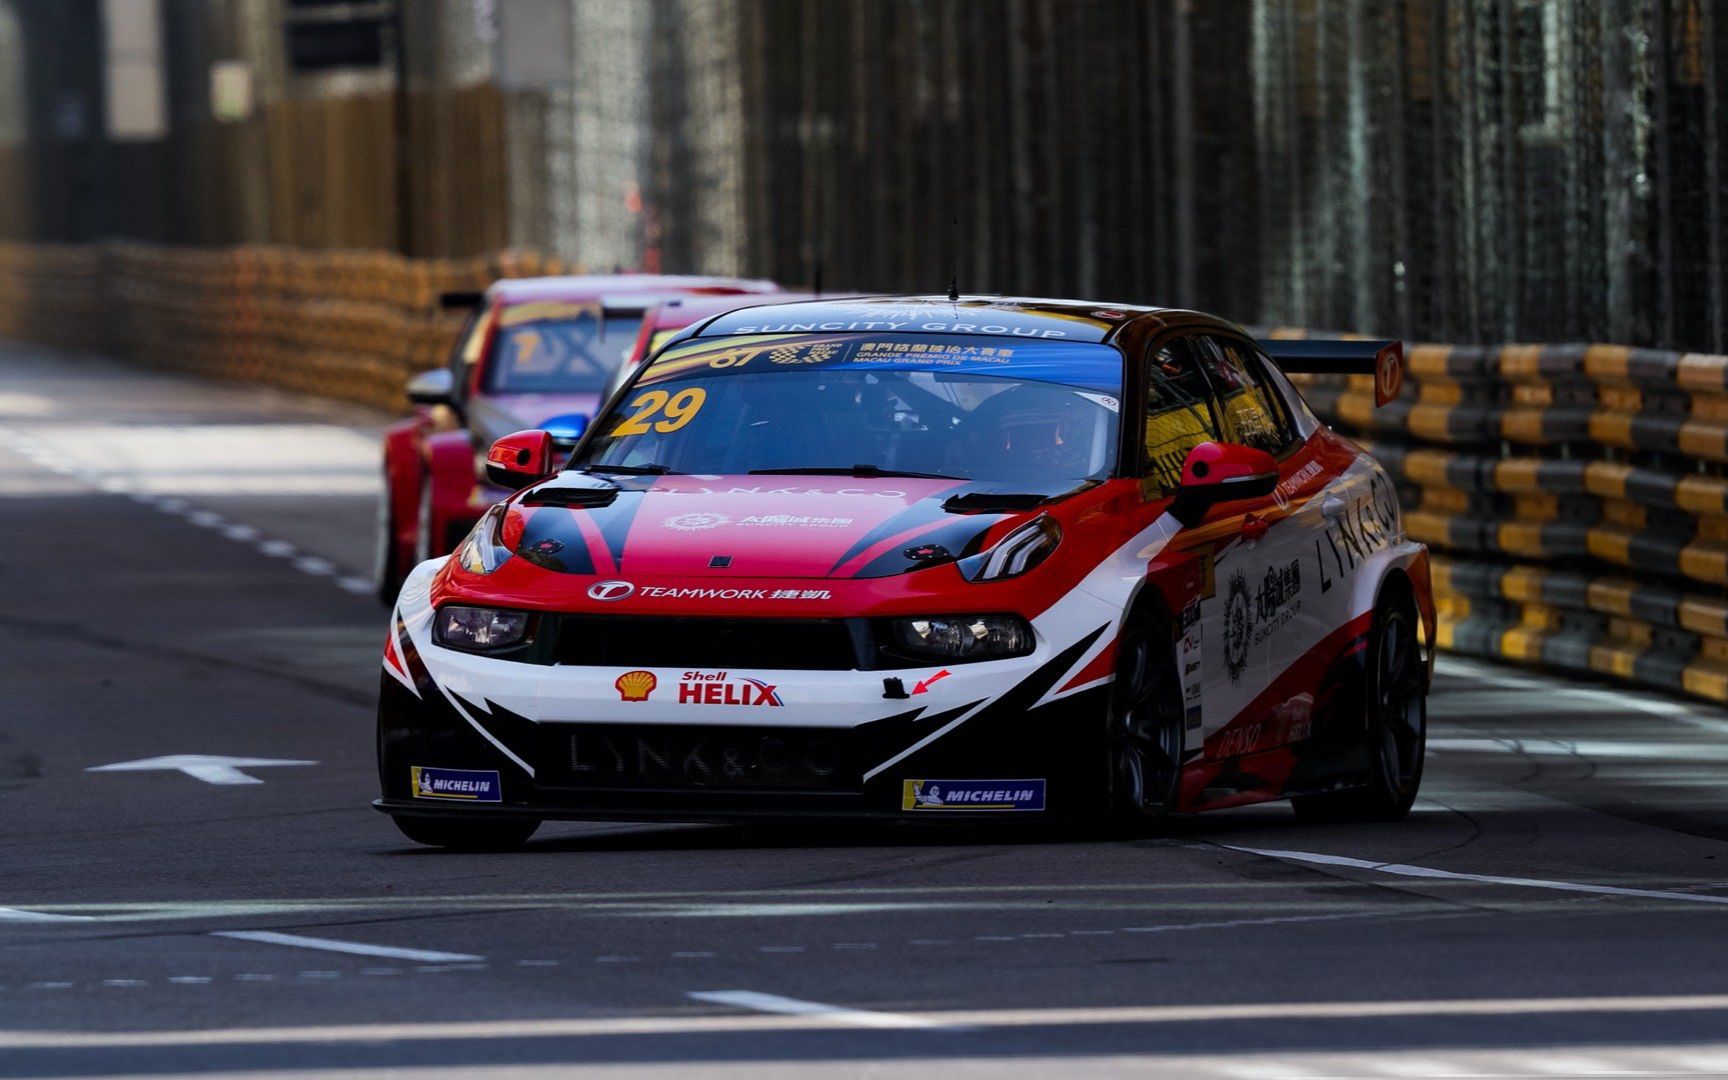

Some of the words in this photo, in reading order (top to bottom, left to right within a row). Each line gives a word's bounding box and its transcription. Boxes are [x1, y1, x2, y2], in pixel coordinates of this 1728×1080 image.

[734, 321, 908, 335] SUNCITY
[921, 322, 1067, 339] GROUP
[969, 356, 1010, 364] MACAU
[610, 387, 707, 437] 29
[639, 586, 768, 600] TEAMWORK
[768, 588, 832, 600] 捷凱
[682, 671, 727, 682] Shell
[678, 683, 781, 707] HELIX
[433, 778, 491, 793] MICHELIN
[945, 789, 1034, 802] MICHELIN
